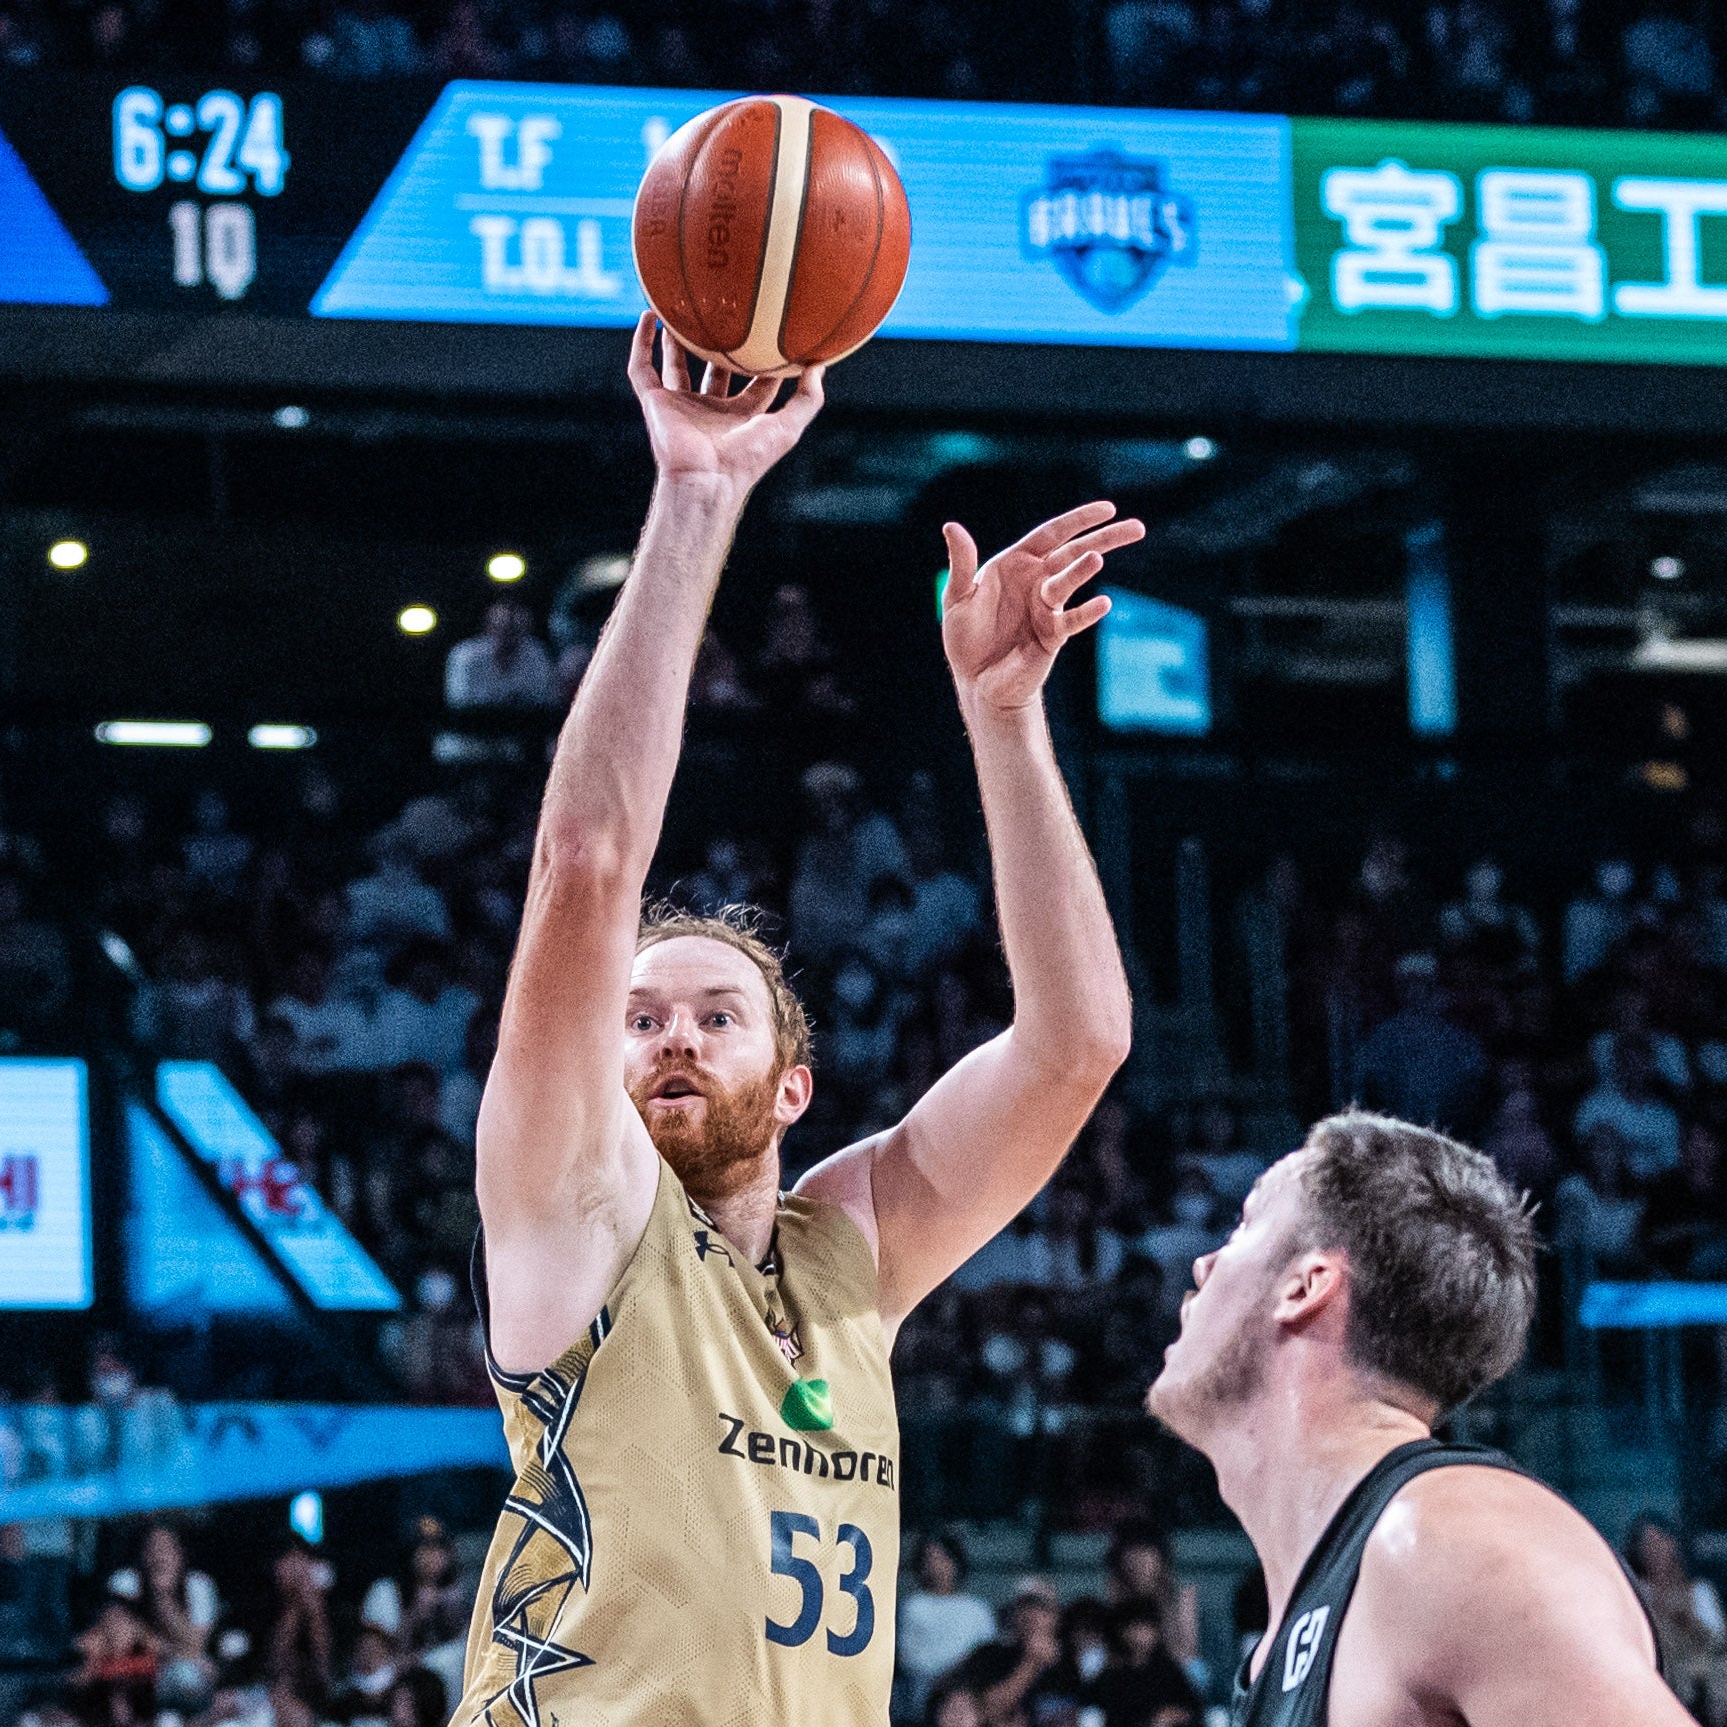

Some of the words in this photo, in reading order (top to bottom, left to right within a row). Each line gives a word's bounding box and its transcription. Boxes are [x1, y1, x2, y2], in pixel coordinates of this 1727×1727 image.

[112, 85, 291, 197] 6:24
[707, 147, 743, 268] molten
[765, 1511, 875, 1657] 53
